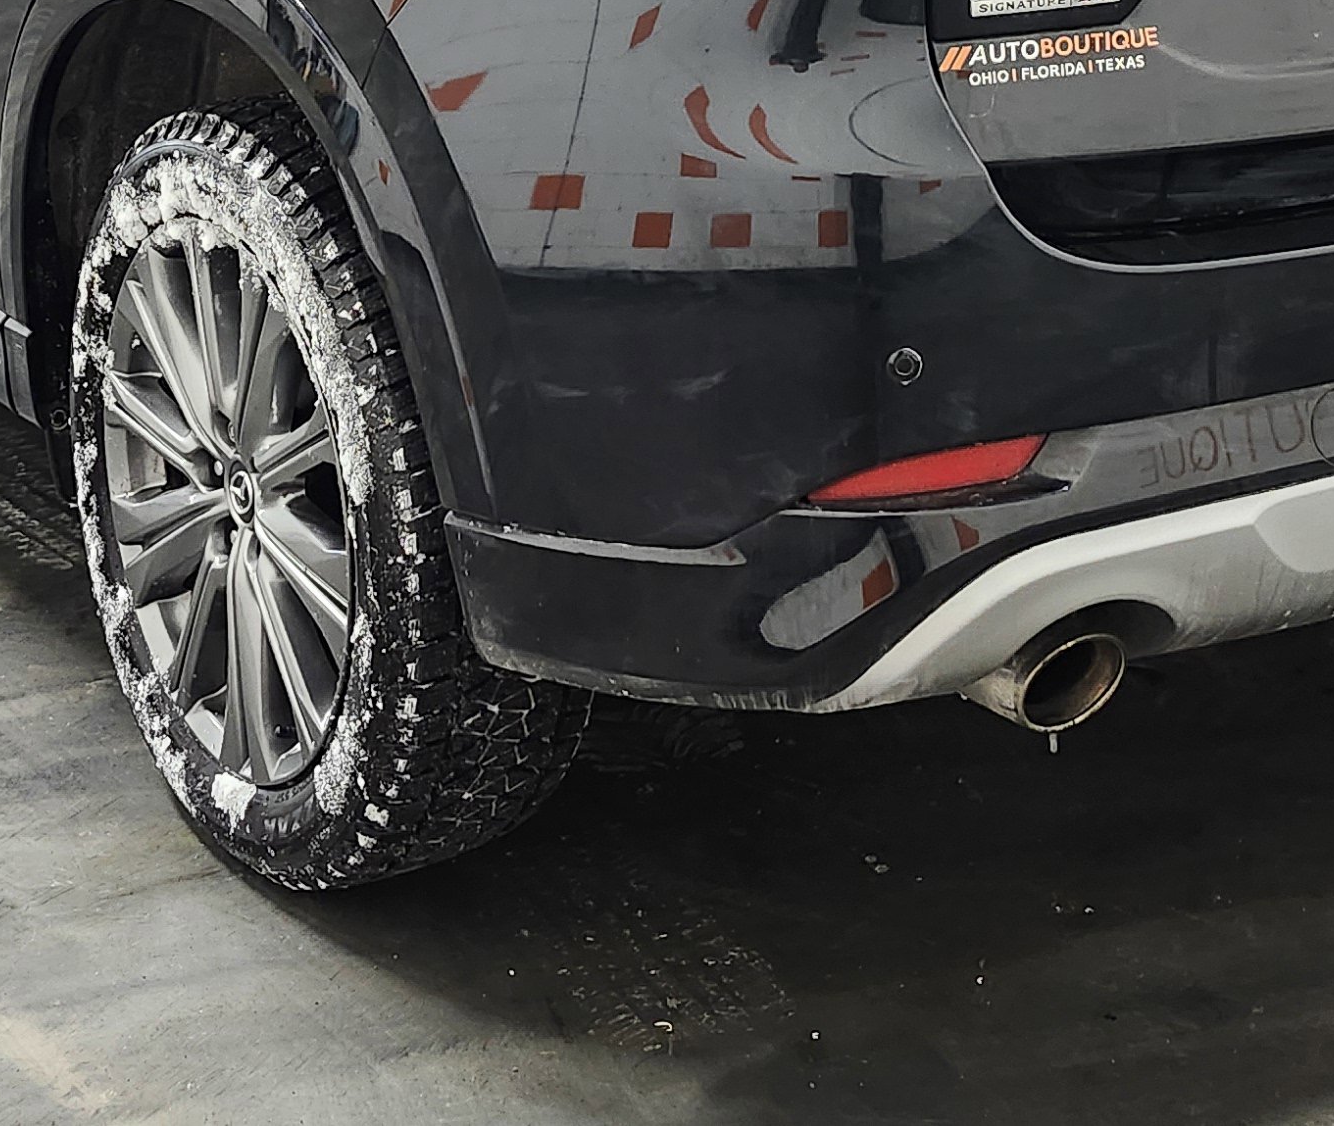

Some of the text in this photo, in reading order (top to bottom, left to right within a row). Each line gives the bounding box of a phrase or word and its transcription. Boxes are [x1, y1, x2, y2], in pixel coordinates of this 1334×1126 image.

[968, 26, 1160, 67] AUTOBOUTIQUE
[968, 54, 1147, 87] OHIO FLORIDA TEXAS
